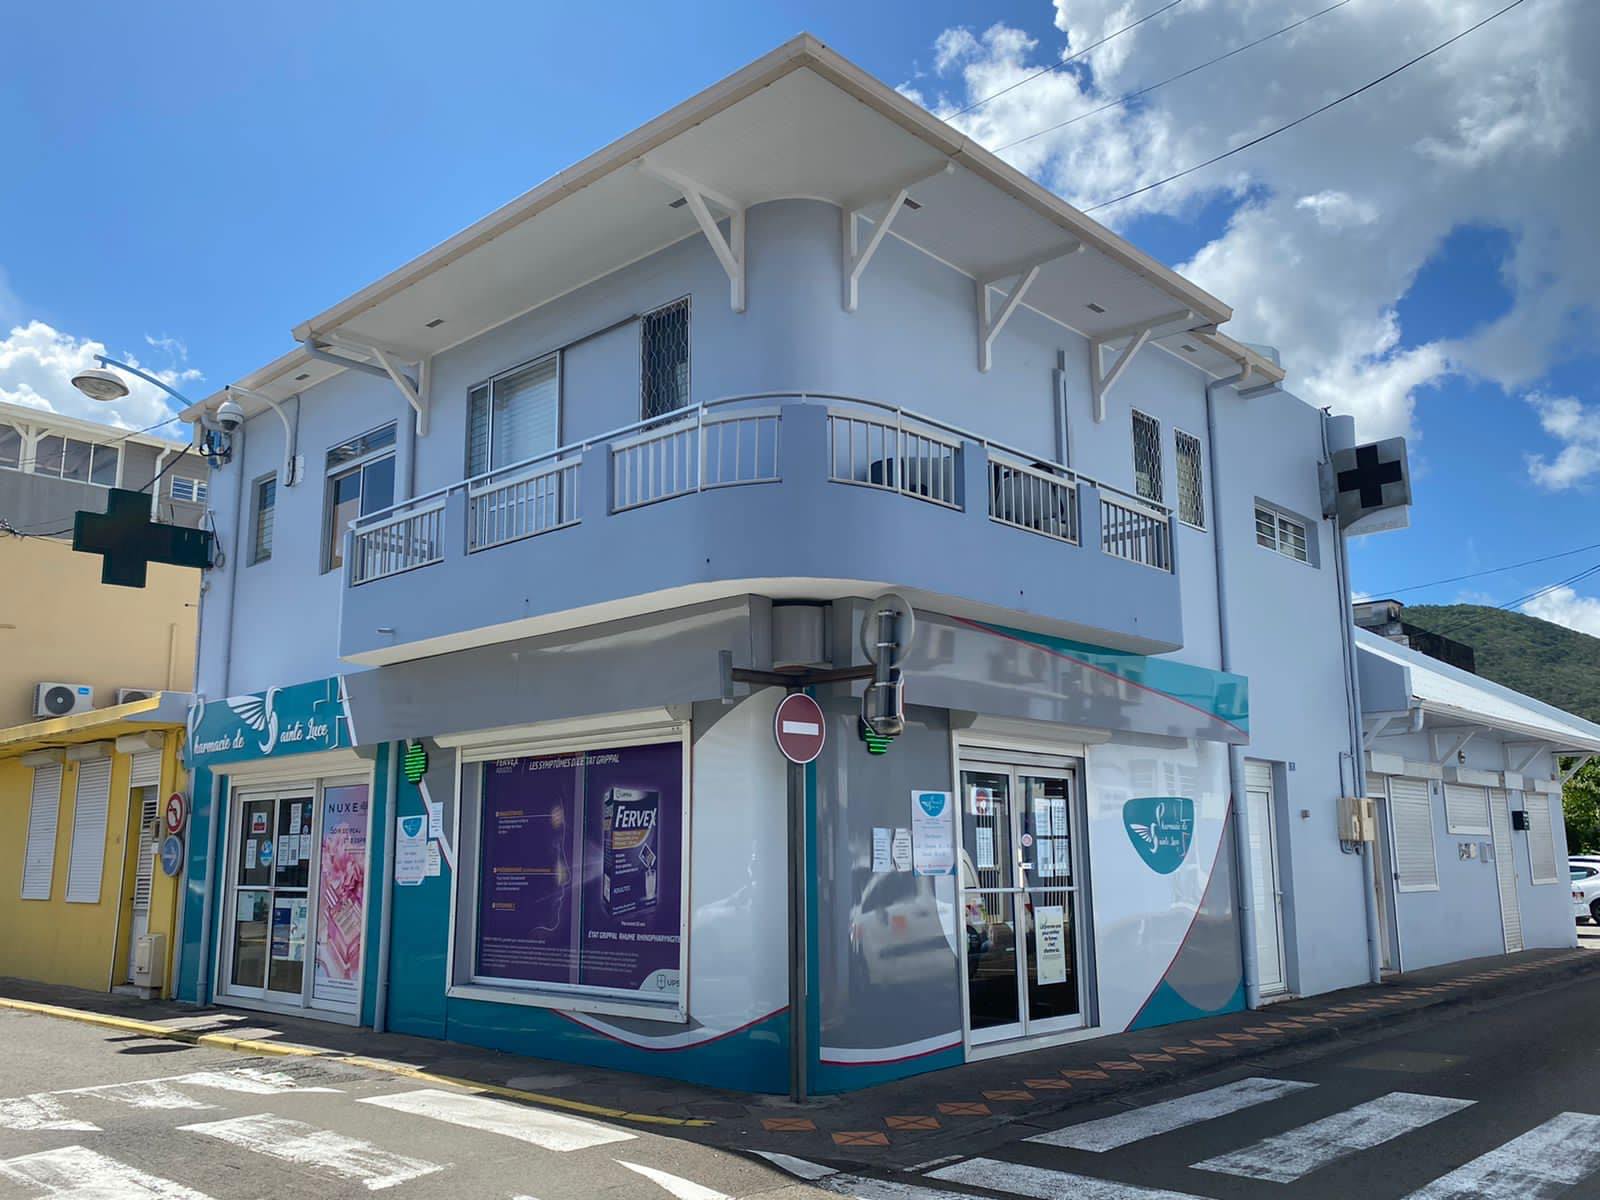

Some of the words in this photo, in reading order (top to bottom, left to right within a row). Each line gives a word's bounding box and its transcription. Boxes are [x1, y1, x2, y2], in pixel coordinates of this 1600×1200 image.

[187, 692, 231, 760] Pharmacie
[233, 728, 245, 748] de
[258, 686, 303, 755] Sainte
[306, 716, 329, 744] Luce
[328, 802, 359, 813] NUXE
[615, 805, 657, 829] FERVEX
